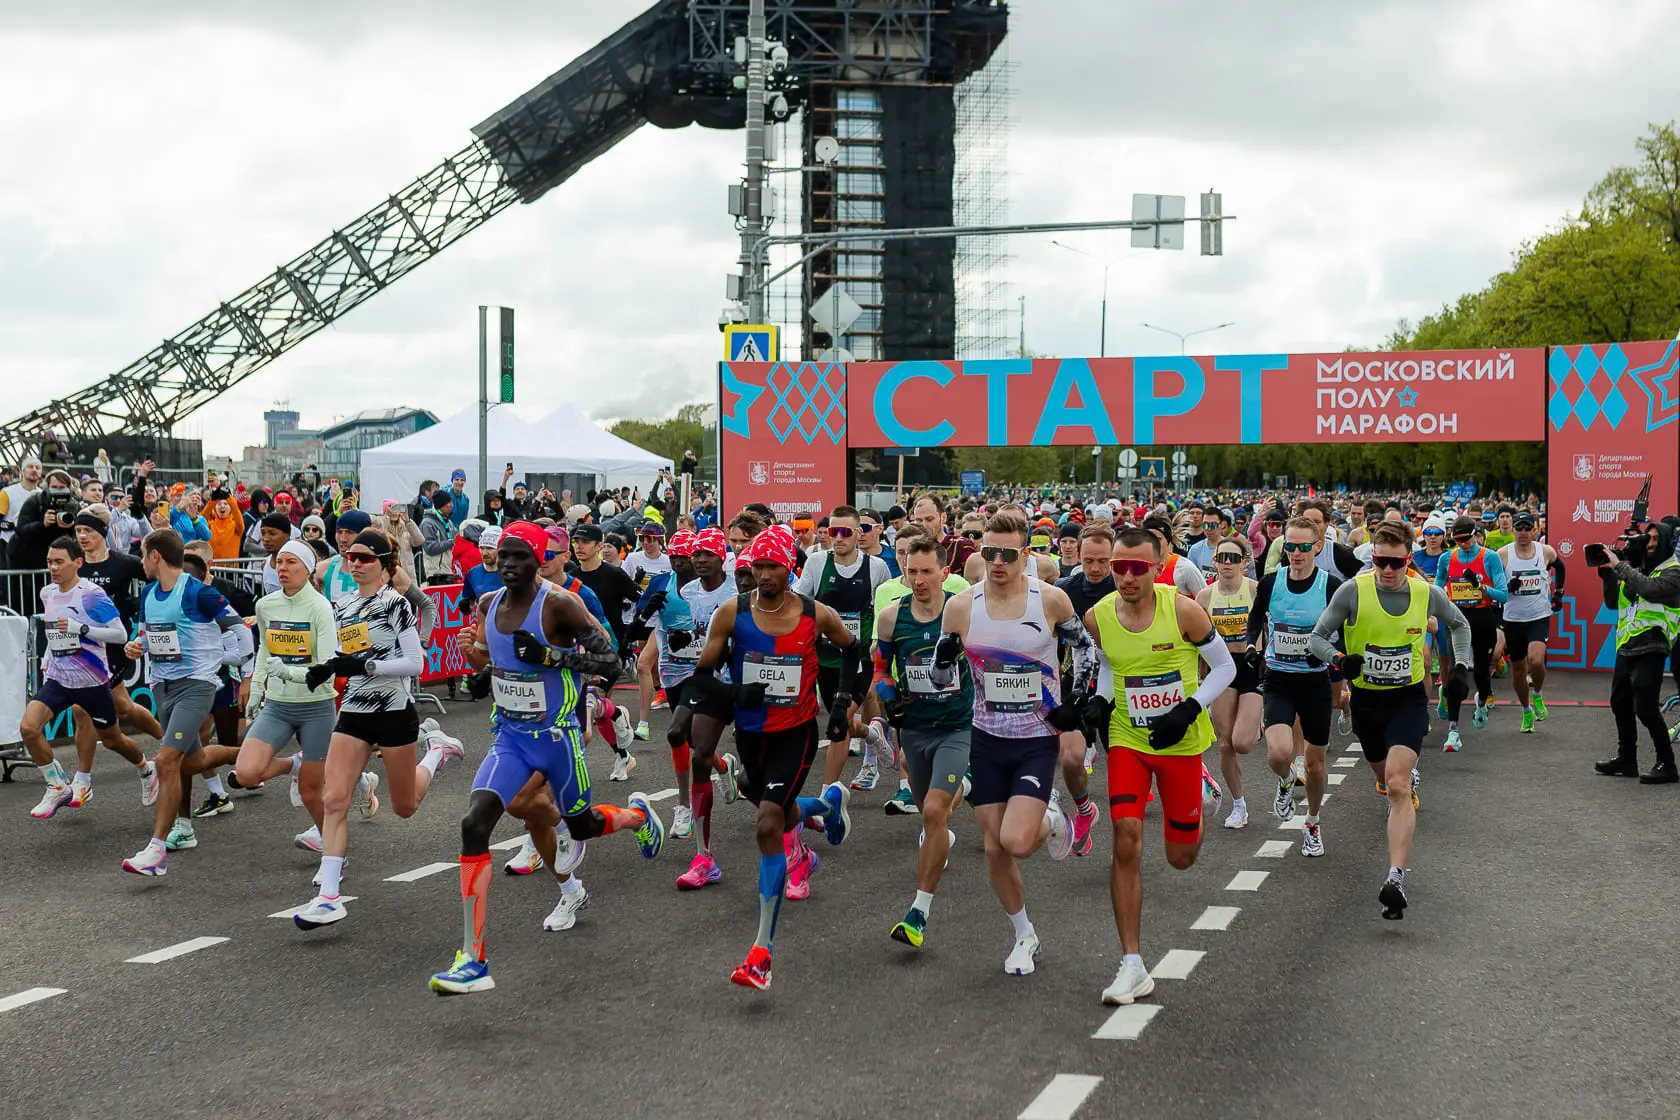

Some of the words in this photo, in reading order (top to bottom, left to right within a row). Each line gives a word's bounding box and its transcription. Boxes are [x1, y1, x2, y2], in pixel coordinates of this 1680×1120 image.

[1317, 353, 1515, 383] МОСКОВСКИЙ
[873, 354, 1288, 447] СТАРТ
[1317, 387, 1395, 408] ПОЛУ
[1317, 413, 1458, 434] МАРАФОН
[1598, 454, 1643, 462] Департамент
[1598, 463, 1622, 471] спорта
[1599, 472, 1621, 480] города
[770, 500, 822, 513] МОСКОВСКИЙ
[1594, 500, 1635, 511] МОСКОВС
[775, 513, 795, 523] ПОРТ
[1594, 512, 1619, 523] СПОРТ
[48, 632, 78, 640] ЕРТЫКОВ
[271, 633, 305, 644] ТРОПИНА
[340, 628, 361, 642] СЕДОВА
[1278, 635, 1310, 645] ТАЛАНО
[1367, 656, 1410, 671] 10738
[759, 668, 786, 681] GELA
[995, 677, 1030, 688] БЯКИН
[1130, 688, 1183, 710] 18864
